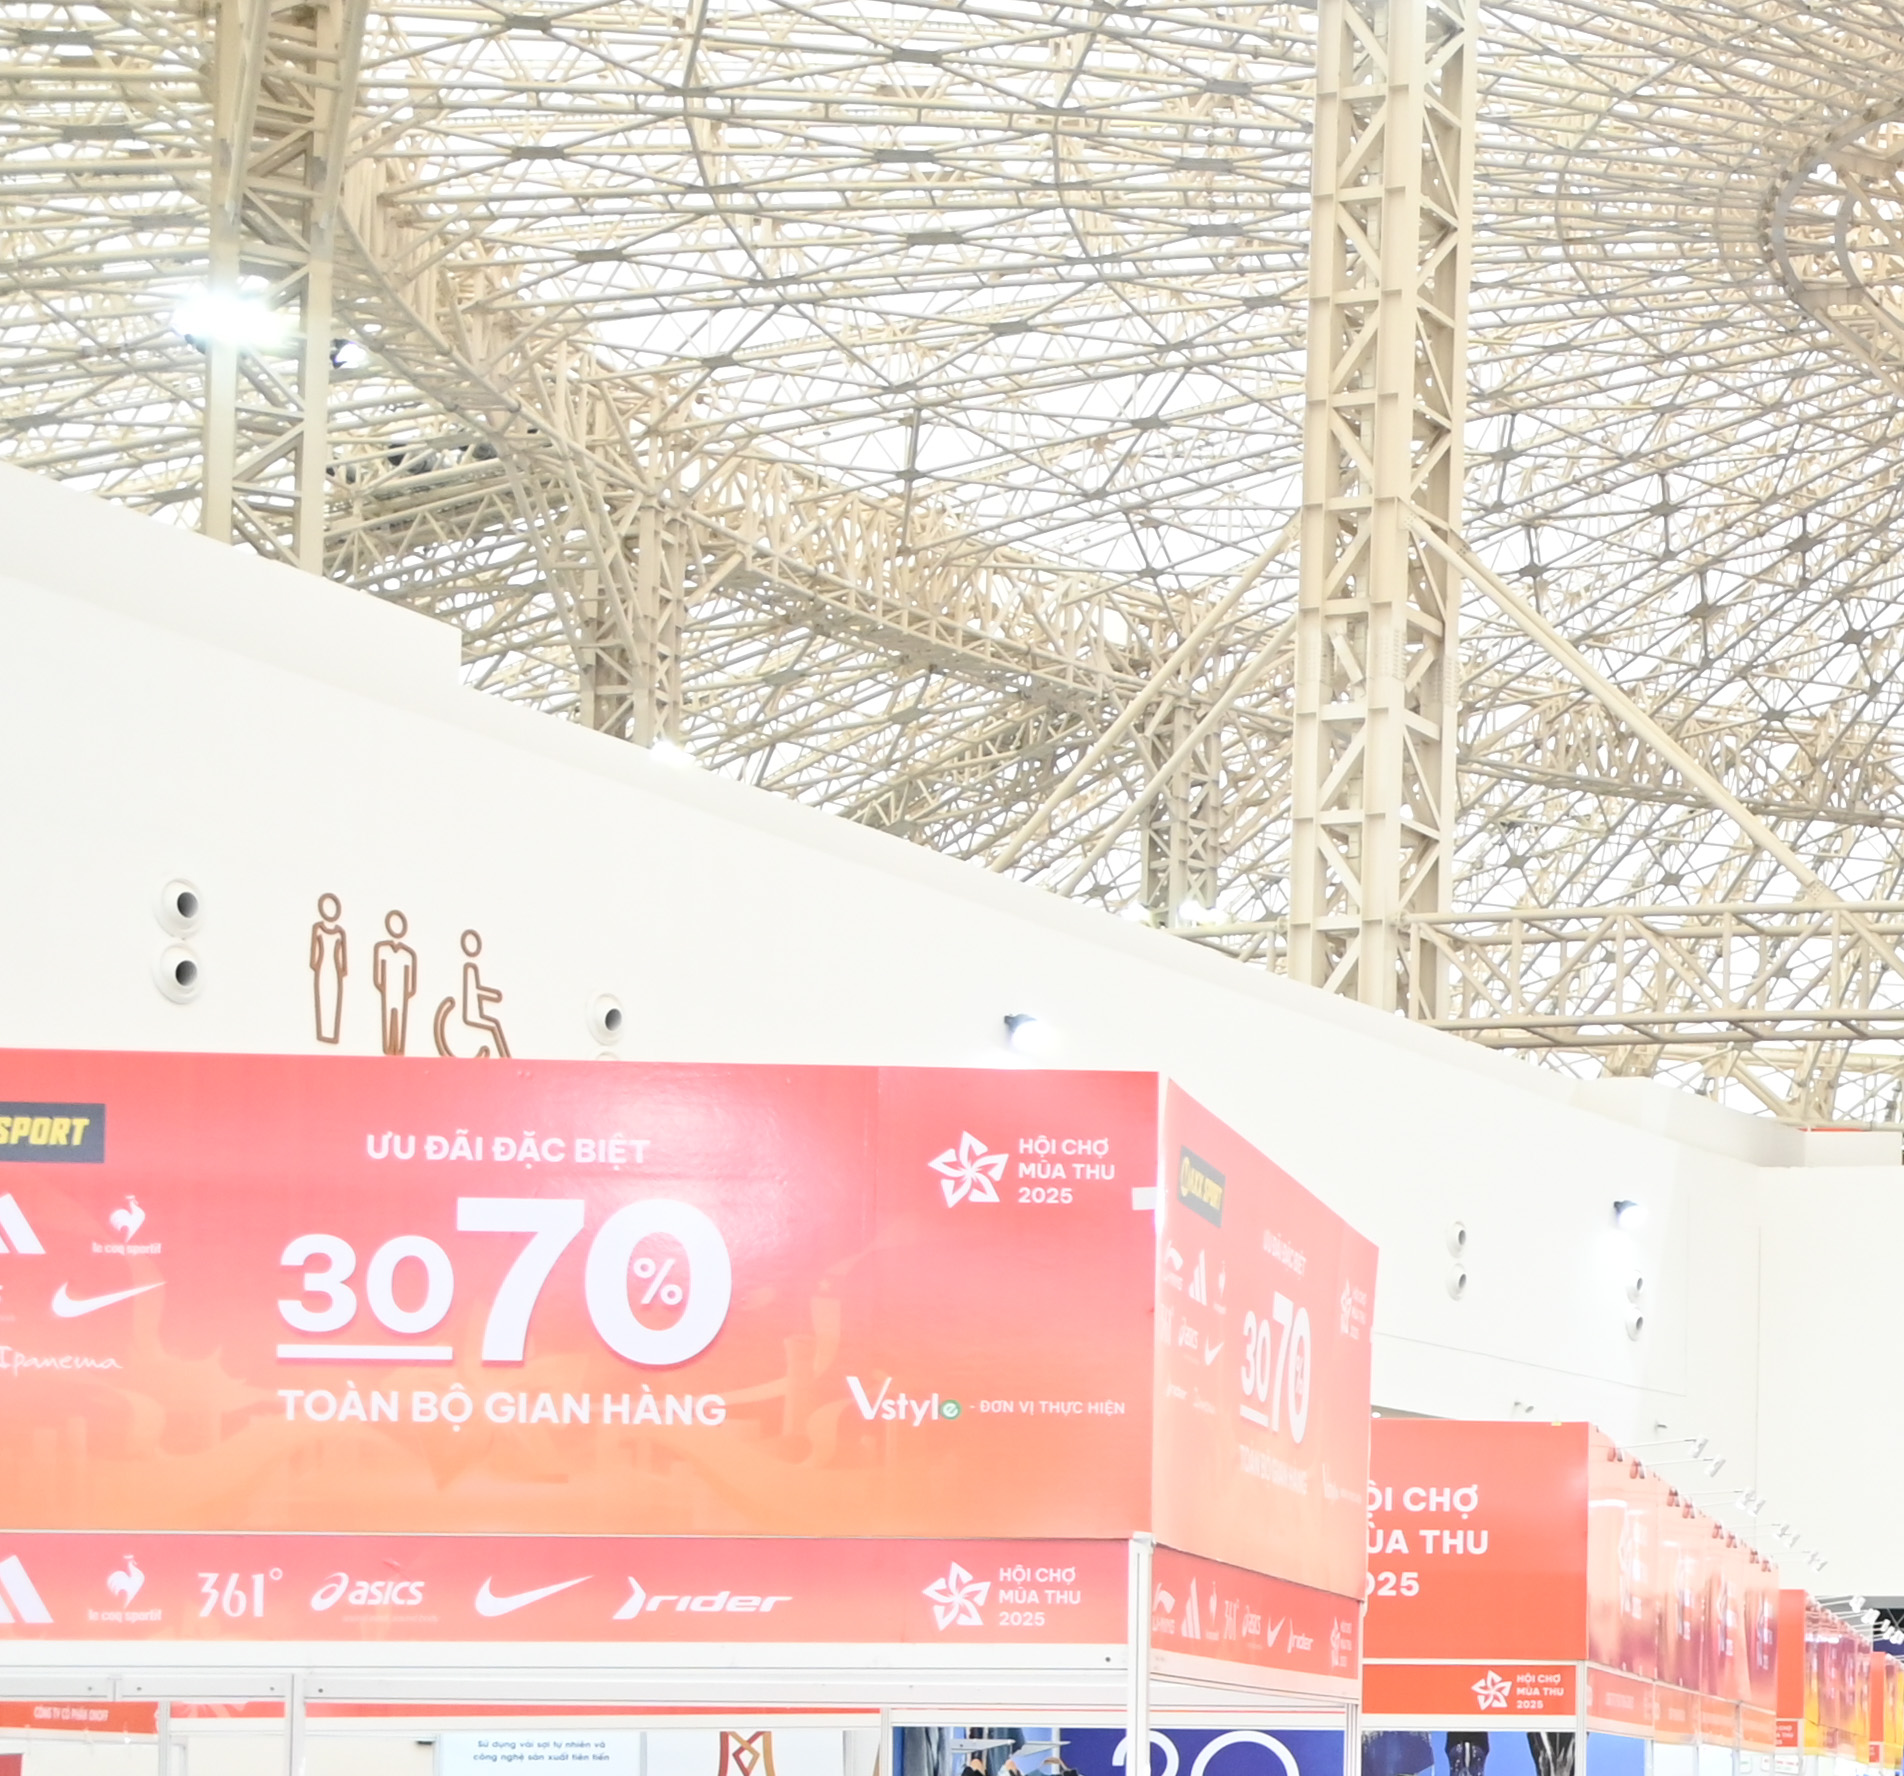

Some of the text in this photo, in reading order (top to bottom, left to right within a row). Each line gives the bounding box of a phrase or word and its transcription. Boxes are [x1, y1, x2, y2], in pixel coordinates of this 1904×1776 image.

[0, 1114, 91, 1150] SPORT
[366, 1128, 651, 1173] ƯU ĐÃI ĐẶC BIỆT
[1018, 1134, 1110, 1159] HỘI CHỢ
[1018, 1159, 1115, 1181] MÙA THU
[1018, 1186, 1074, 1204] 2025
[276, 1380, 727, 1433] TOÀN BỘ GIAN HÀNG
[980, 1399, 1126, 1417] ĐƠN VỊ THỰC HIỆN
[1402, 1484, 1479, 1520] CHỢ
[1419, 1530, 1490, 1555] THU
[999, 1564, 1076, 1586] HỘI CHỢ
[197, 1567, 283, 1618] 361°
[347, 1580, 425, 1606] asics
[645, 1590, 793, 1613] rider
[1044, 1589, 1081, 1605] THU
[101, 1609, 162, 1624] coq sportif
[999, 1611, 1046, 1627] 2025
[1516, 1672, 1562, 1686] HỘI CHỢ
[1543, 1687, 1565, 1698] THU
[1516, 1699, 1544, 1710] 2025
